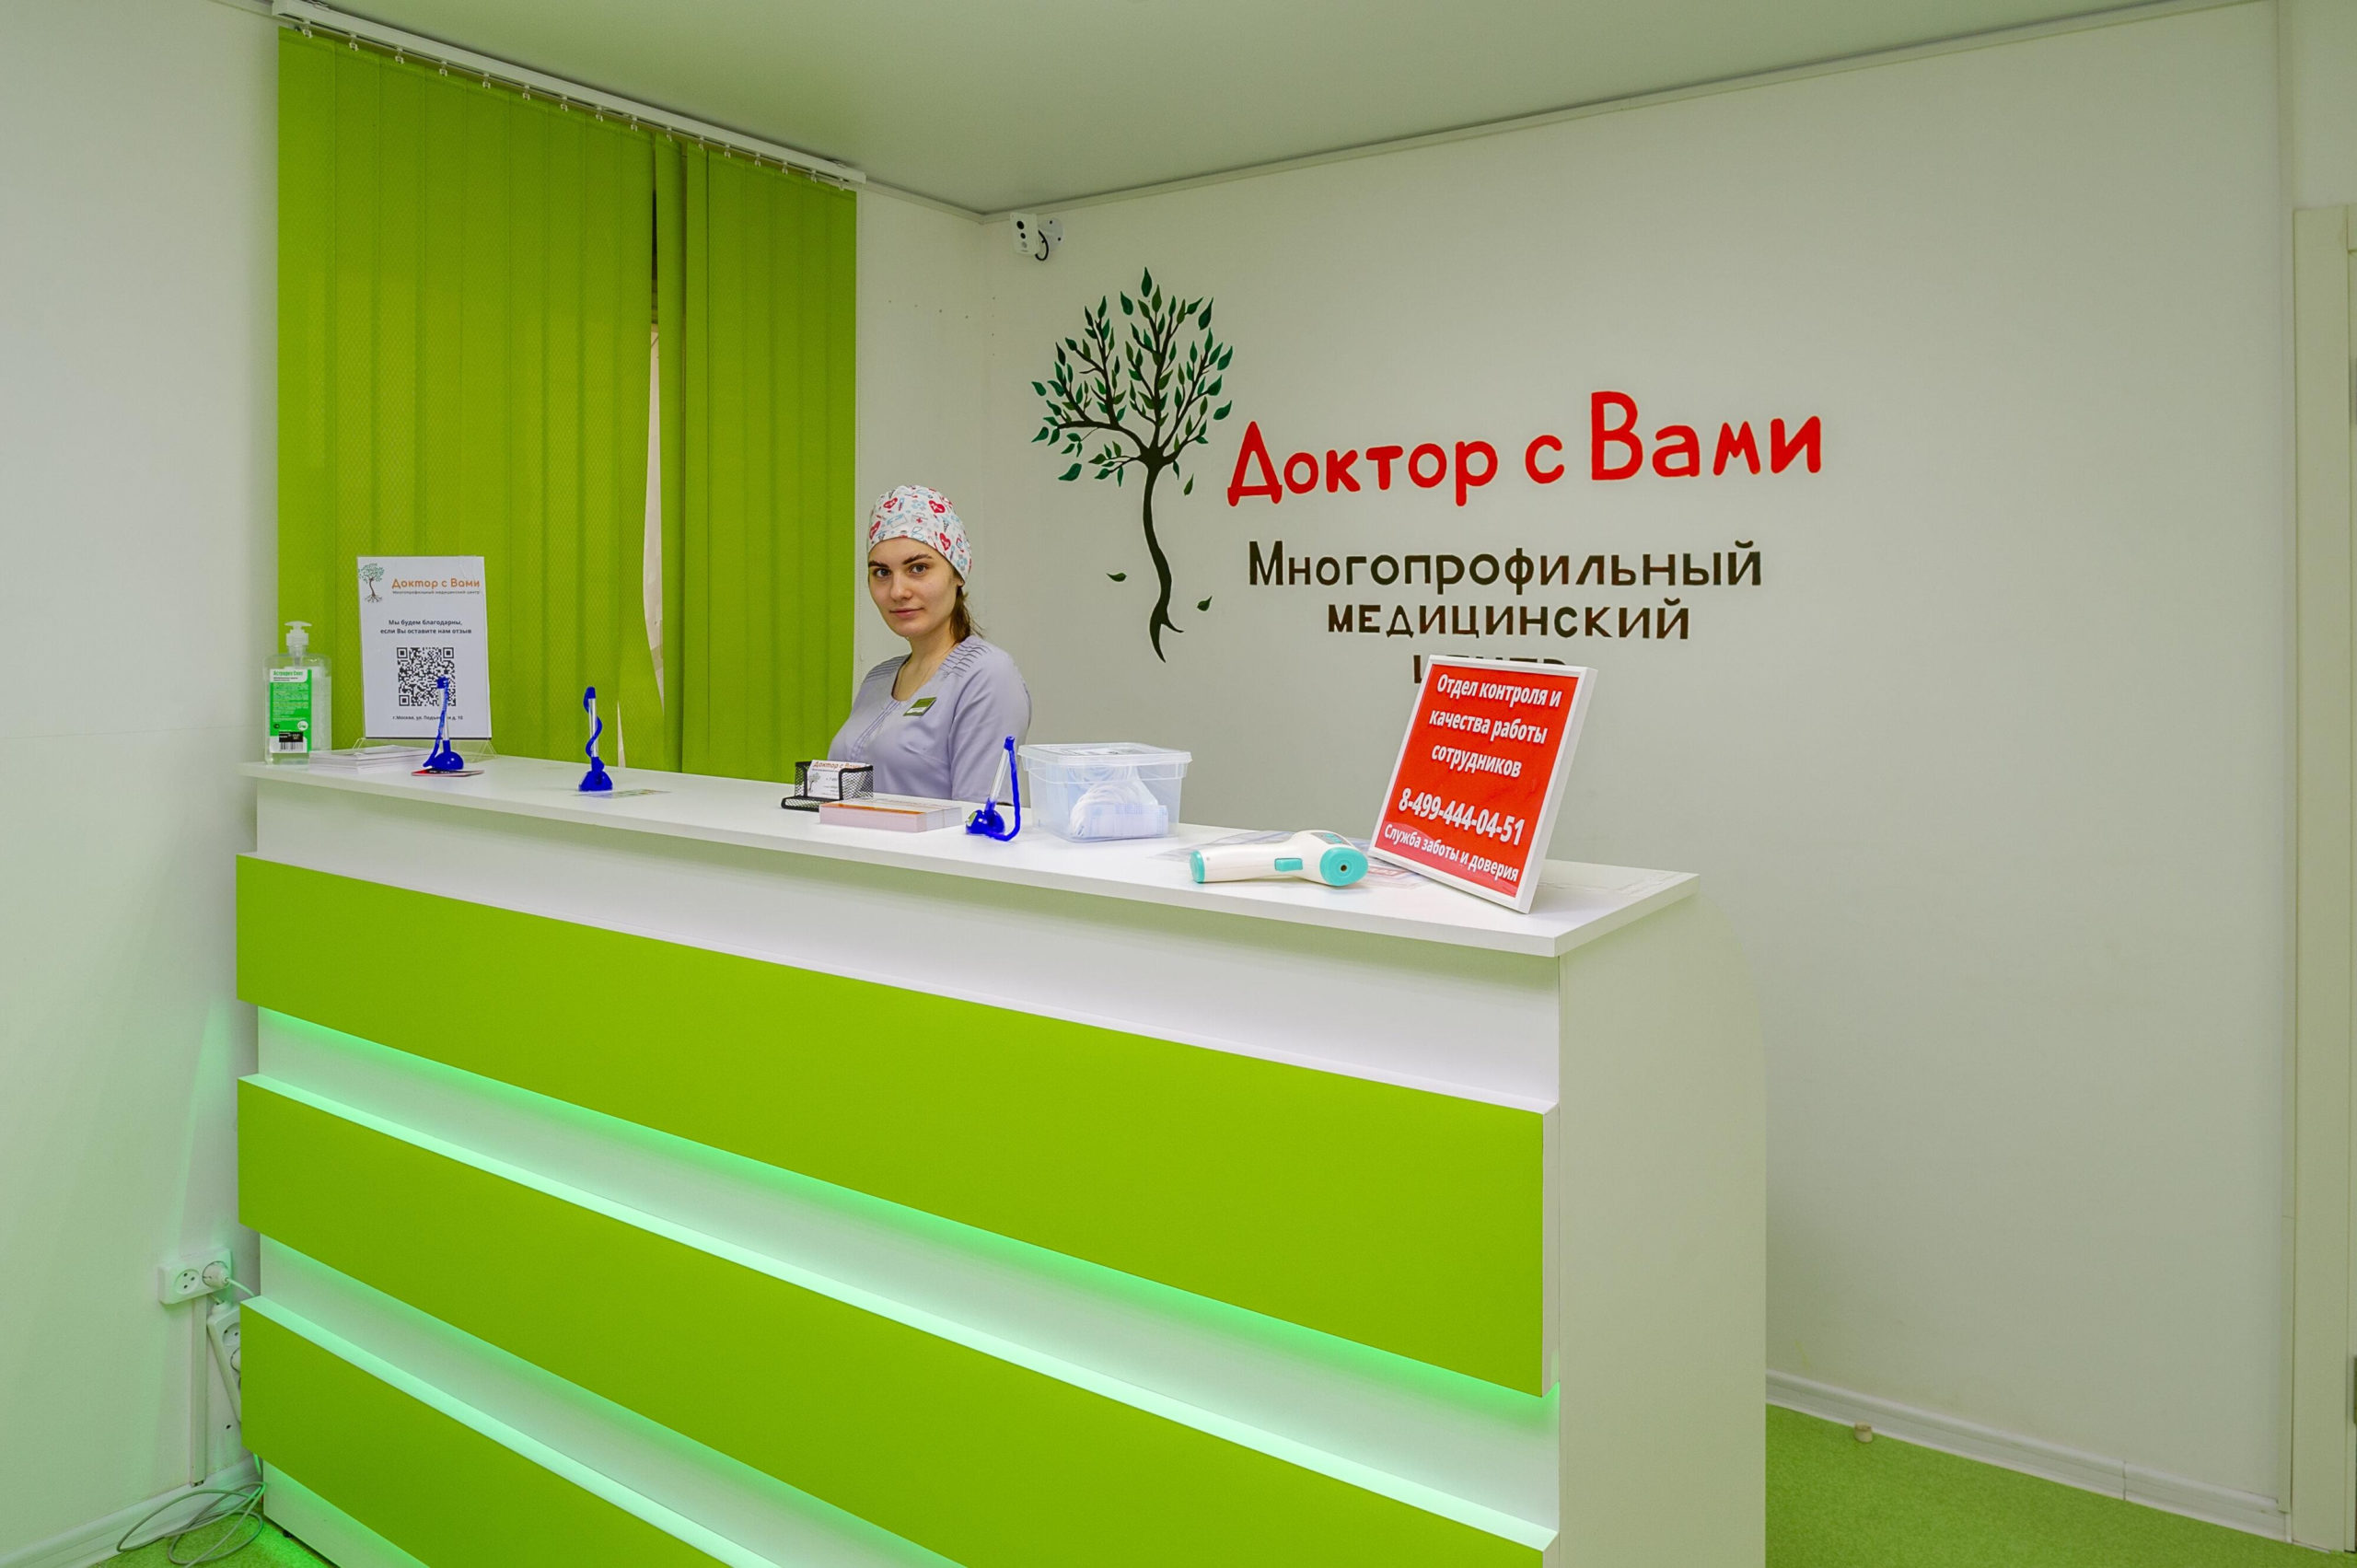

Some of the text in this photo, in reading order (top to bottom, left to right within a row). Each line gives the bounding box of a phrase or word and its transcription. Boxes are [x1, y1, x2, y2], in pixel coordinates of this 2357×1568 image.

[1227, 390, 1822, 506] Доктор с Вами
[391, 578, 438, 589] Доктор
[450, 577, 480, 587] Вами
[1248, 540, 1761, 596] Многопрофильный
[1328, 598, 1689, 640] медицинский
[1436, 674, 1563, 708] Отдел контроля и
[1428, 710, 1549, 744] качества работы
[1430, 744, 1523, 778] сотрудников
[1398, 787, 1527, 847] 8-499-444-04-51
[1384, 823, 1519, 882] Служба заботы и доверия
